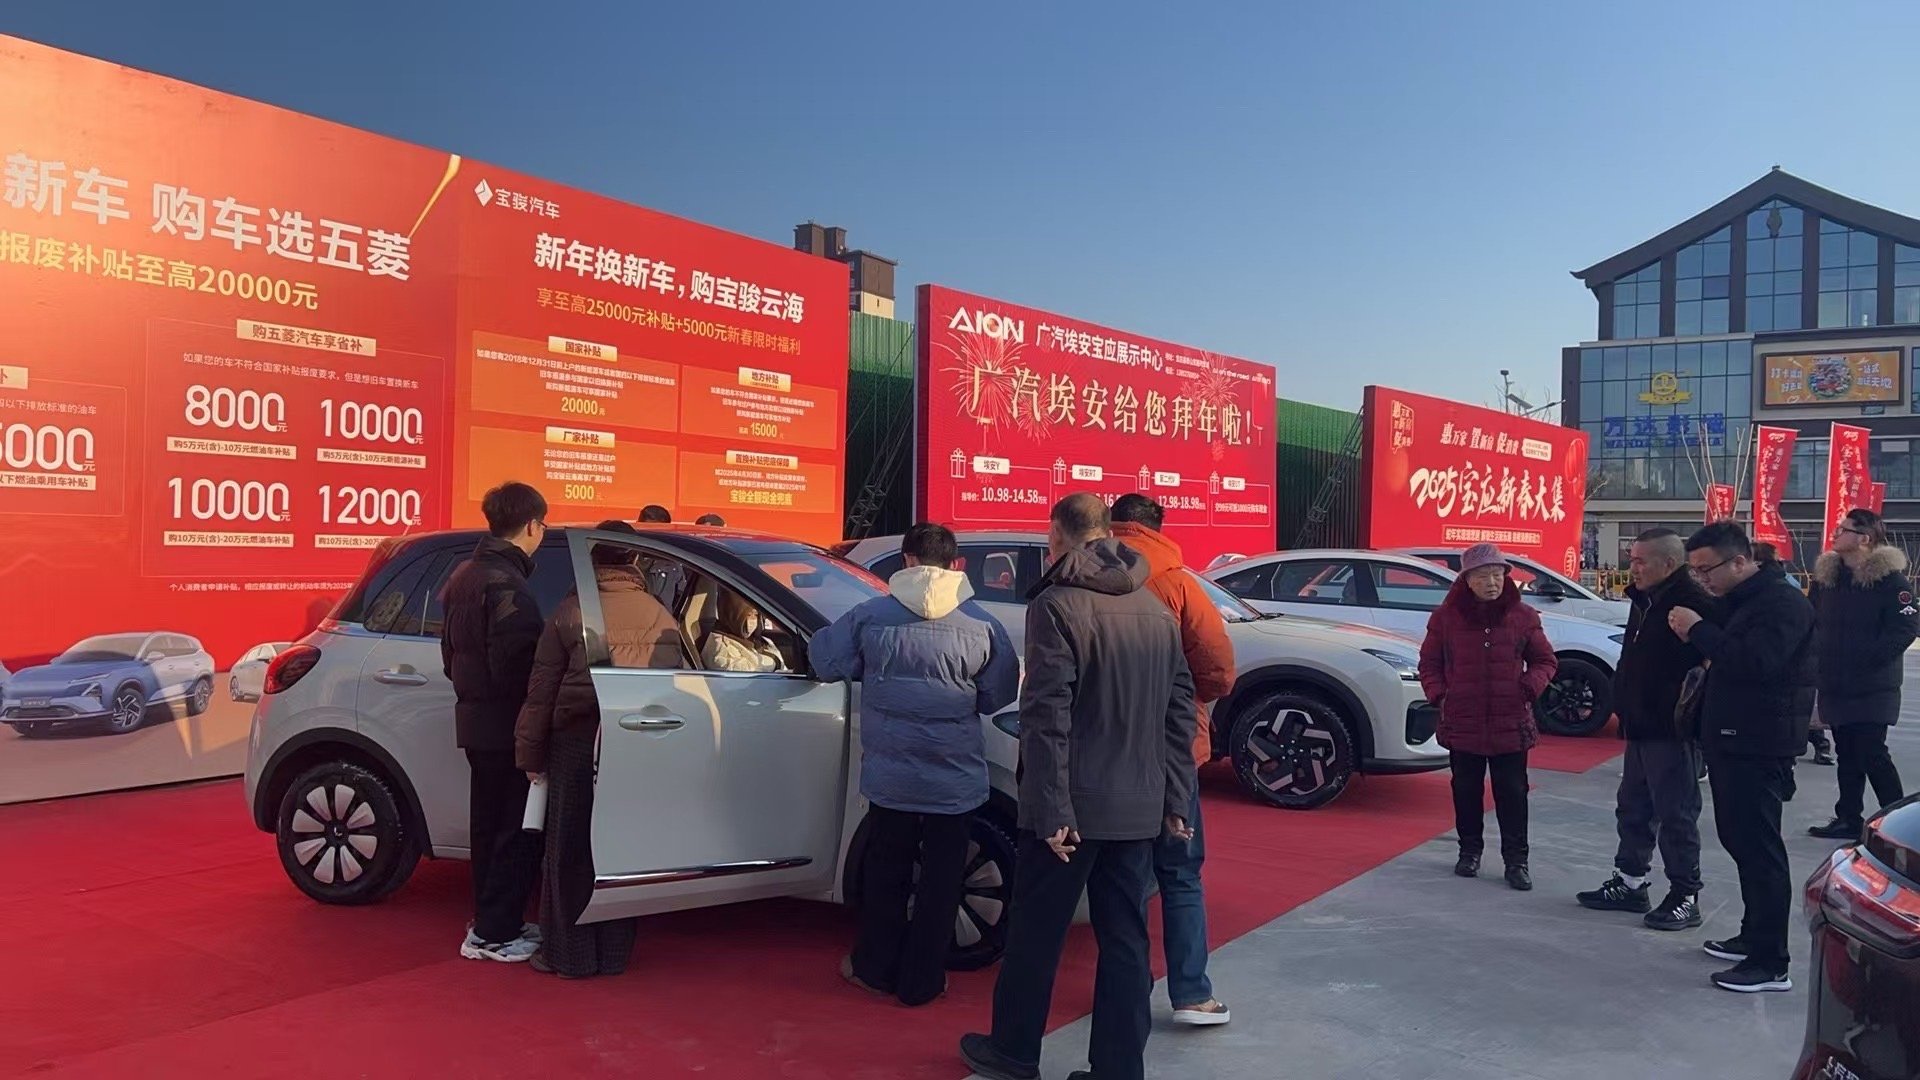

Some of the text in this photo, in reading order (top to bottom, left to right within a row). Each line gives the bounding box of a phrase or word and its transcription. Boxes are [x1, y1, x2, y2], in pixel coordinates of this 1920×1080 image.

[3, 151, 411, 281] 新车 购车选五菱
[495, 187, 560, 219] 宝骏汽车
[0, 229, 320, 310] 报废补贴至高20000元
[252, 323, 364, 352] 购五菱汽车享省补
[536, 286, 801, 356] 享至高25000元补贴+5000元新春限时福利
[949, 306, 1025, 343] AION
[564, 340, 602, 358] 国家补贴
[1036, 323, 1163, 372] 广汽埃安宝应展示中心
[563, 430, 600, 445] 厂家补贴
